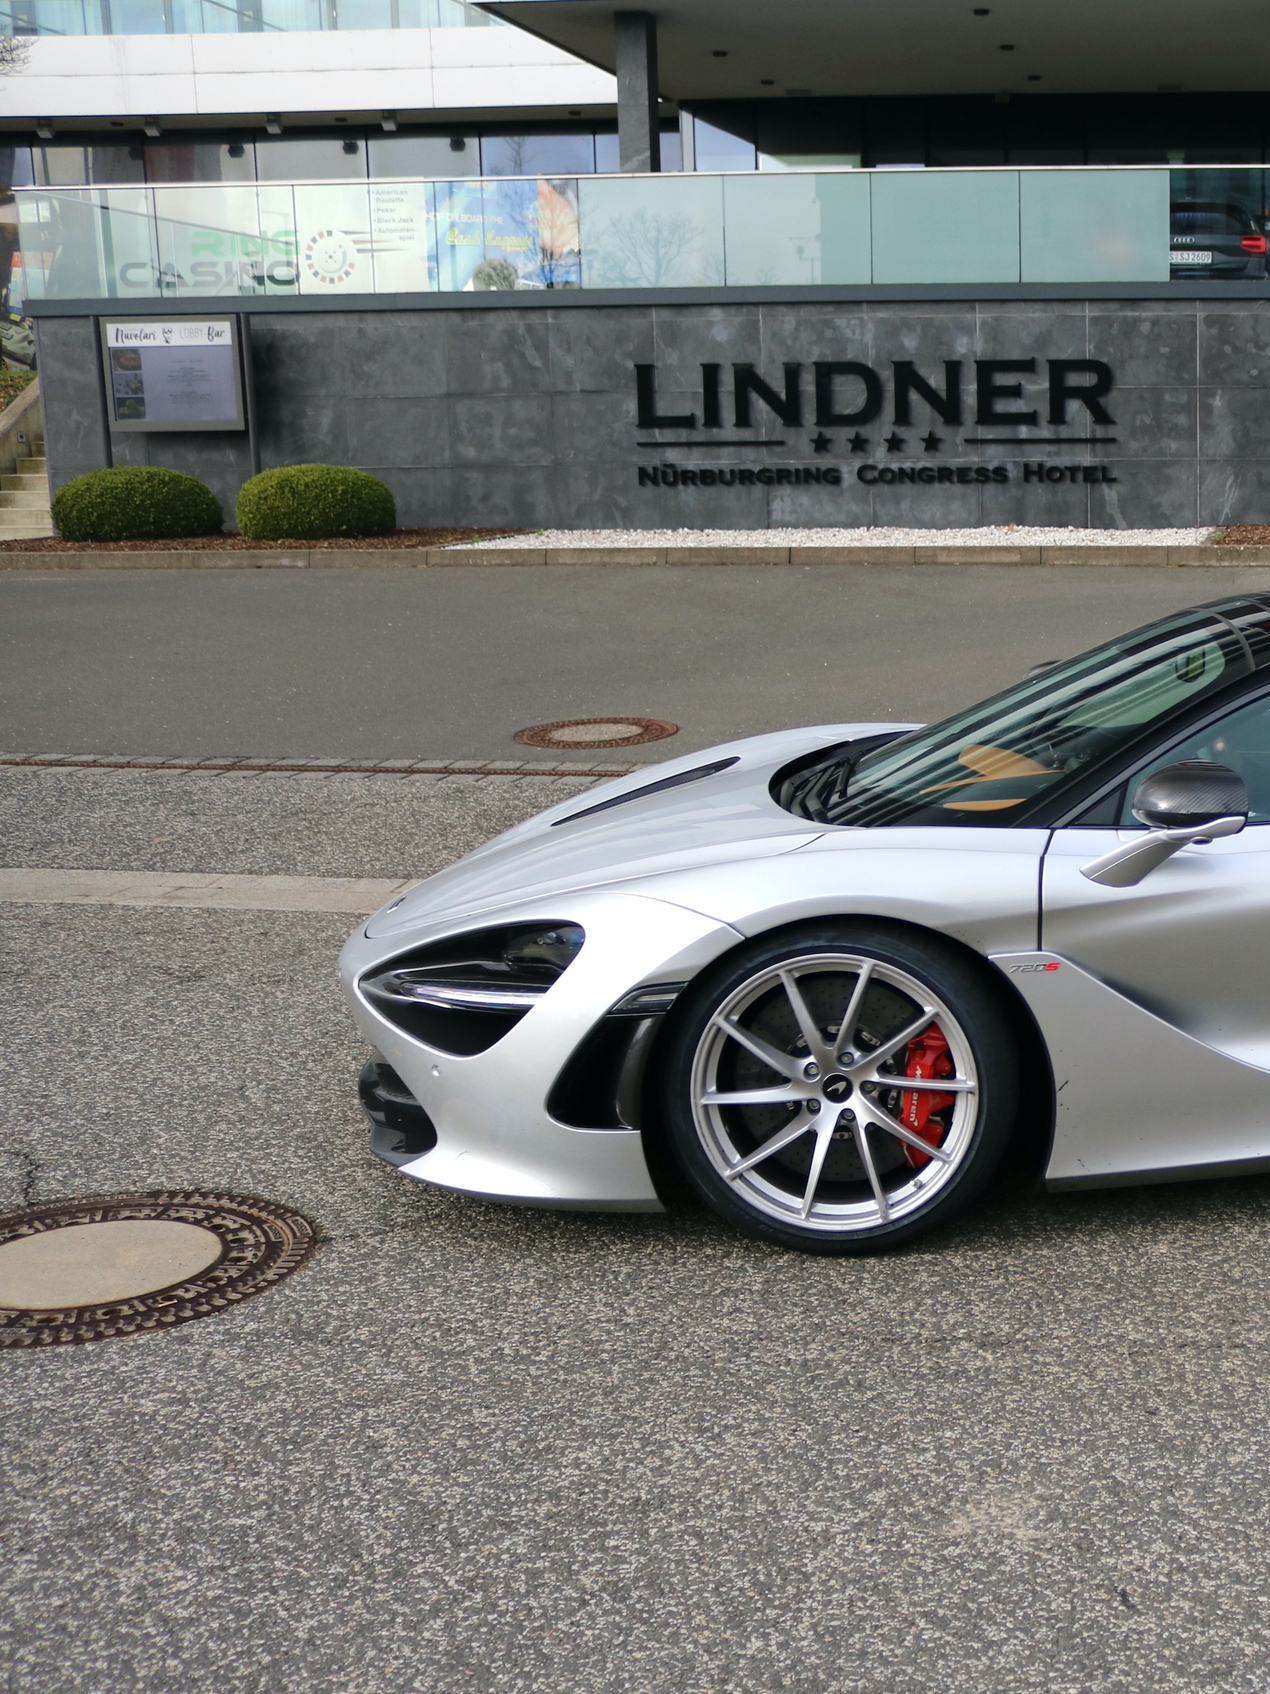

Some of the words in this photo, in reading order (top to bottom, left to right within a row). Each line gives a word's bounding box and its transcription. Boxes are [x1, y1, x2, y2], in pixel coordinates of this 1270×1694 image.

[192, 230, 300, 257] RING
[1191, 252, 1211, 262] 2609
[119, 260, 300, 288] CASINO
[634, 357, 1117, 429] LINDNER
[637, 463, 842, 487] NÜRBURGRING
[856, 463, 1010, 486] CONGRESS
[1023, 464, 1118, 485] HOTEL
[1009, 962, 1060, 974] 720S
